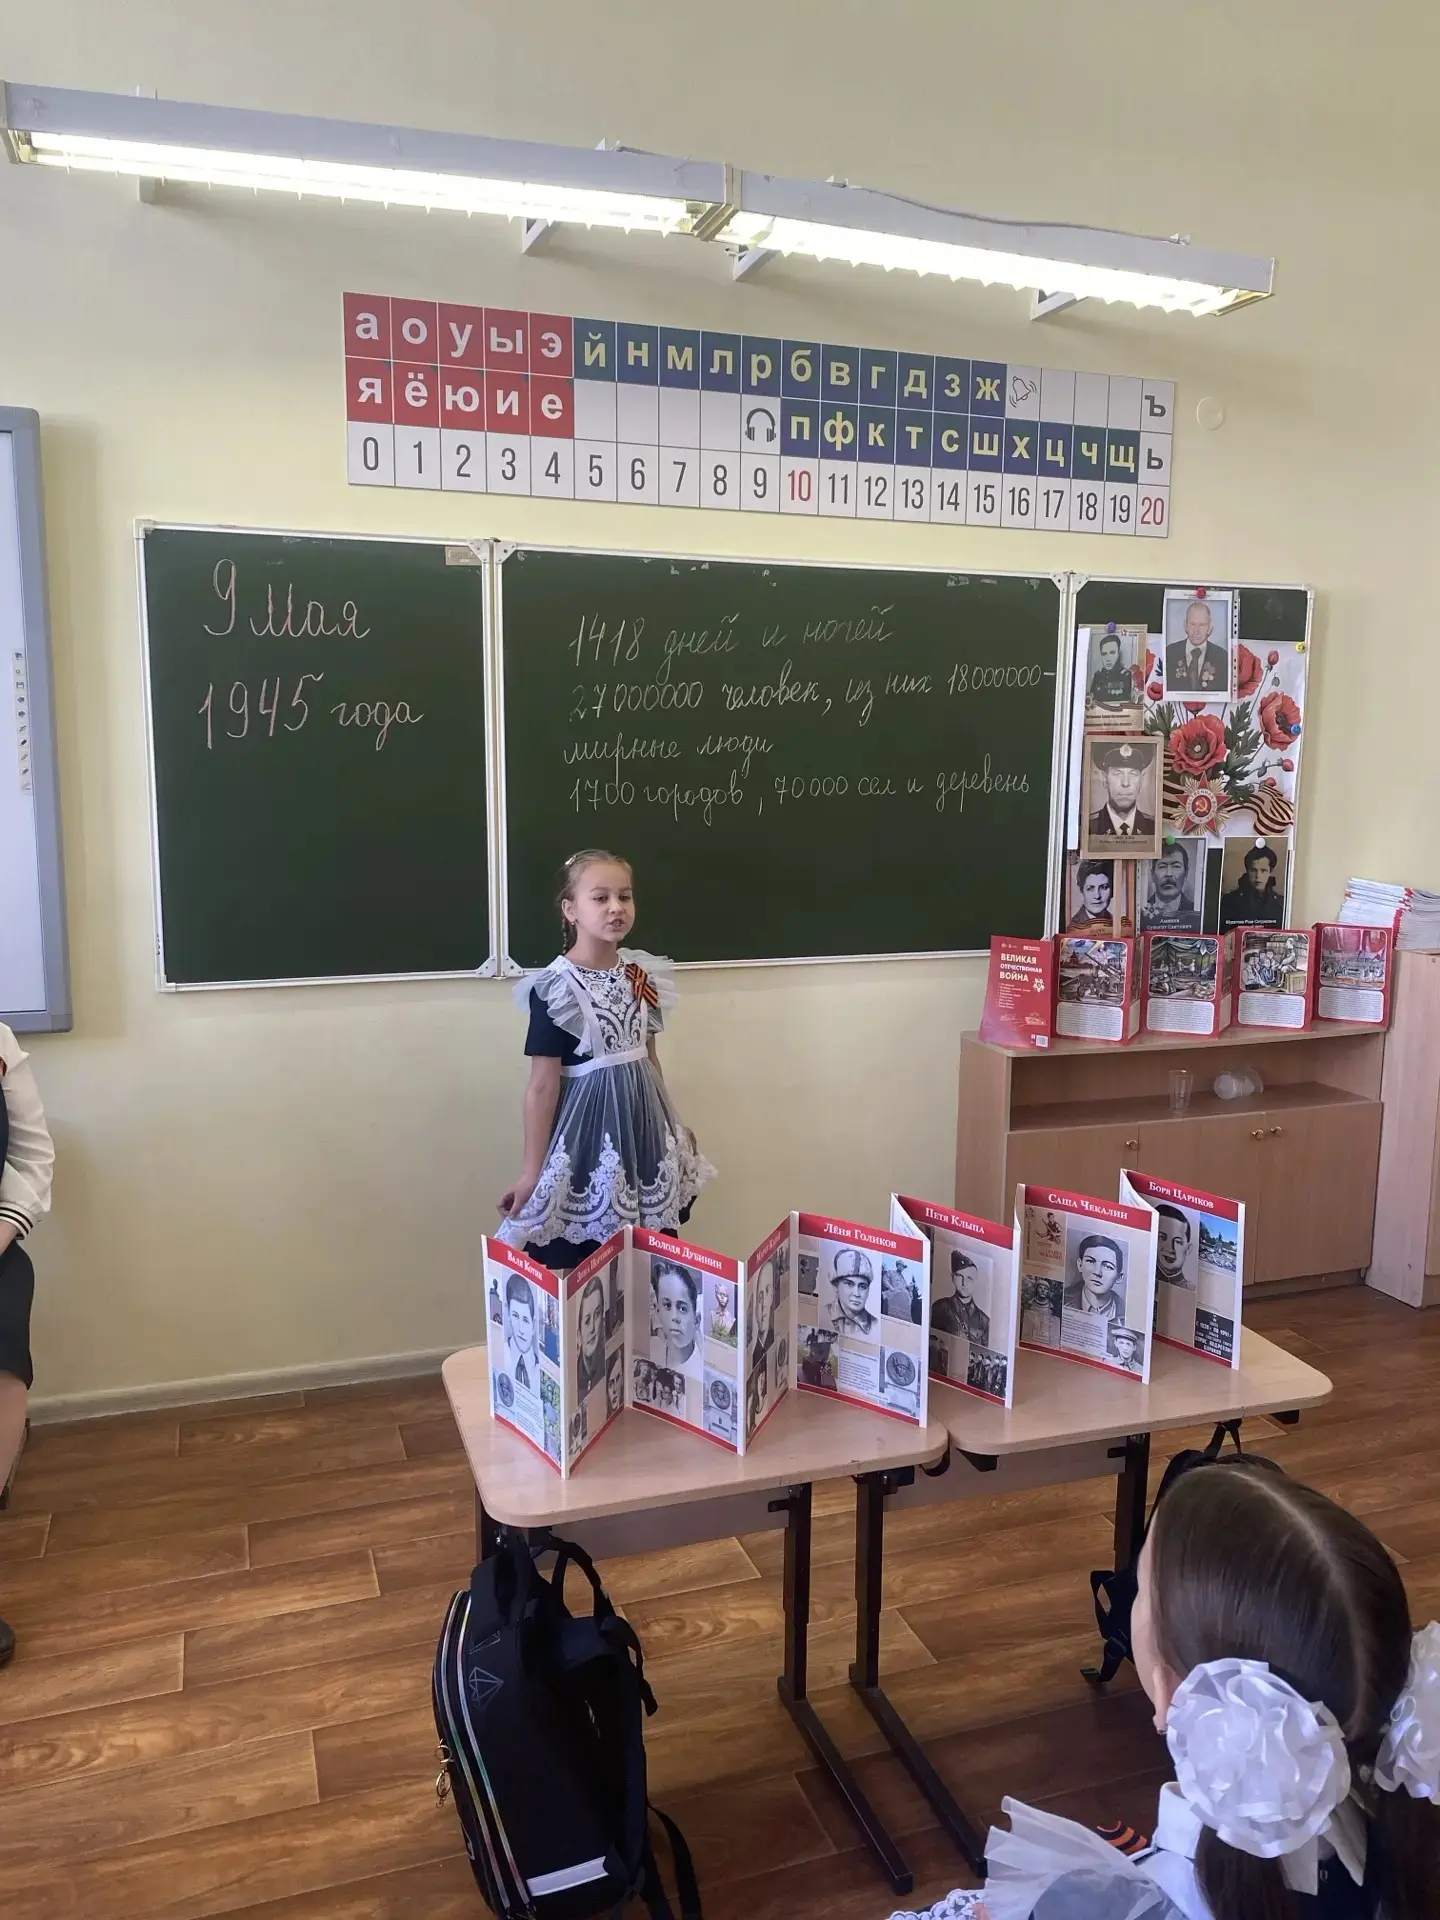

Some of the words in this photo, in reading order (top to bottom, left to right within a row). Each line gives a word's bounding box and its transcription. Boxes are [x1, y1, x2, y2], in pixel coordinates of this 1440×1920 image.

[355, 312, 379, 339] а
[402, 318, 427, 345] о
[449, 322, 473, 358] у
[490, 327, 523, 354] ы
[540, 332, 562, 357] э
[584, 332, 605, 367] й
[628, 342, 648, 366] н
[668, 345, 692, 370] м
[710, 349, 733, 373] л
[750, 353, 772, 385] р
[790, 350, 812, 380] б
[830, 363, 850, 385] в
[871, 365, 888, 388] г
[904, 369, 927, 398] д
[944, 374, 960, 397] з
[976, 378, 1000, 400] ж
[1145, 395, 1166, 416] ъ
[358, 379, 382, 403] я
[405, 372, 428, 407] ё
[445, 388, 479, 411] ю
[498, 393, 518, 415] и
[541, 394, 562, 419] е
[791, 416, 810, 439] п
[824, 412, 854, 450] ф
[868, 423, 884, 446] к
[906, 426, 923, 449] т
[942, 429, 959, 452] с
[974, 432, 998, 455] ш
[1012, 435, 1030, 458] х
[1046, 439, 1064, 466] ц
[1081, 443, 1098, 463] ч
[1110, 445, 1135, 472] щ
[1147, 449, 1163, 469] ь
[363, 437, 378, 471] 0
[413, 441, 423, 474] 1
[456, 445, 470, 478] 2
[501, 448, 516, 480] 3
[545, 451, 560, 483] 4
[589, 455, 603, 486] 5
[631, 458, 645, 490] 6
[673, 462, 686, 492] 7
[713, 465, 727, 495] 8
[754, 467, 767, 498] 9
[788, 471, 811, 501] 10
[828, 474, 848, 504] 11
[865, 476, 887, 507] 12
[902, 479, 924, 509] 13
[938, 482, 959, 511] 14
[974, 484, 995, 513] 15
[1009, 487, 1029, 516] 16
[1044, 490, 1063, 518] 17
[1077, 492, 1097, 520] 18
[1110, 494, 1130, 522] 19
[1141, 497, 1164, 525] 20
[204, 559, 236, 635] 9
[568, 612, 645, 666] 1418
[656, 612, 739, 685] дней
[762, 625, 787, 647] и
[803, 604, 894, 643] ночей
[198, 672, 324, 749] 1945
[330, 701, 424, 751] года
[846, 679, 875, 727] из
[886, 672, 933, 694] них
[564, 732, 681, 783] мирные
[697, 735, 774, 779] люди
[570, 778, 635, 812] 1700
[858, 776, 896, 795] сел
[908, 778, 924, 793] и
[936, 753, 1029, 812] деревень
[1000, 972, 1028, 982] ВОЙНА
[1001, 953, 1036, 964] ВЕЛИКАЯ
